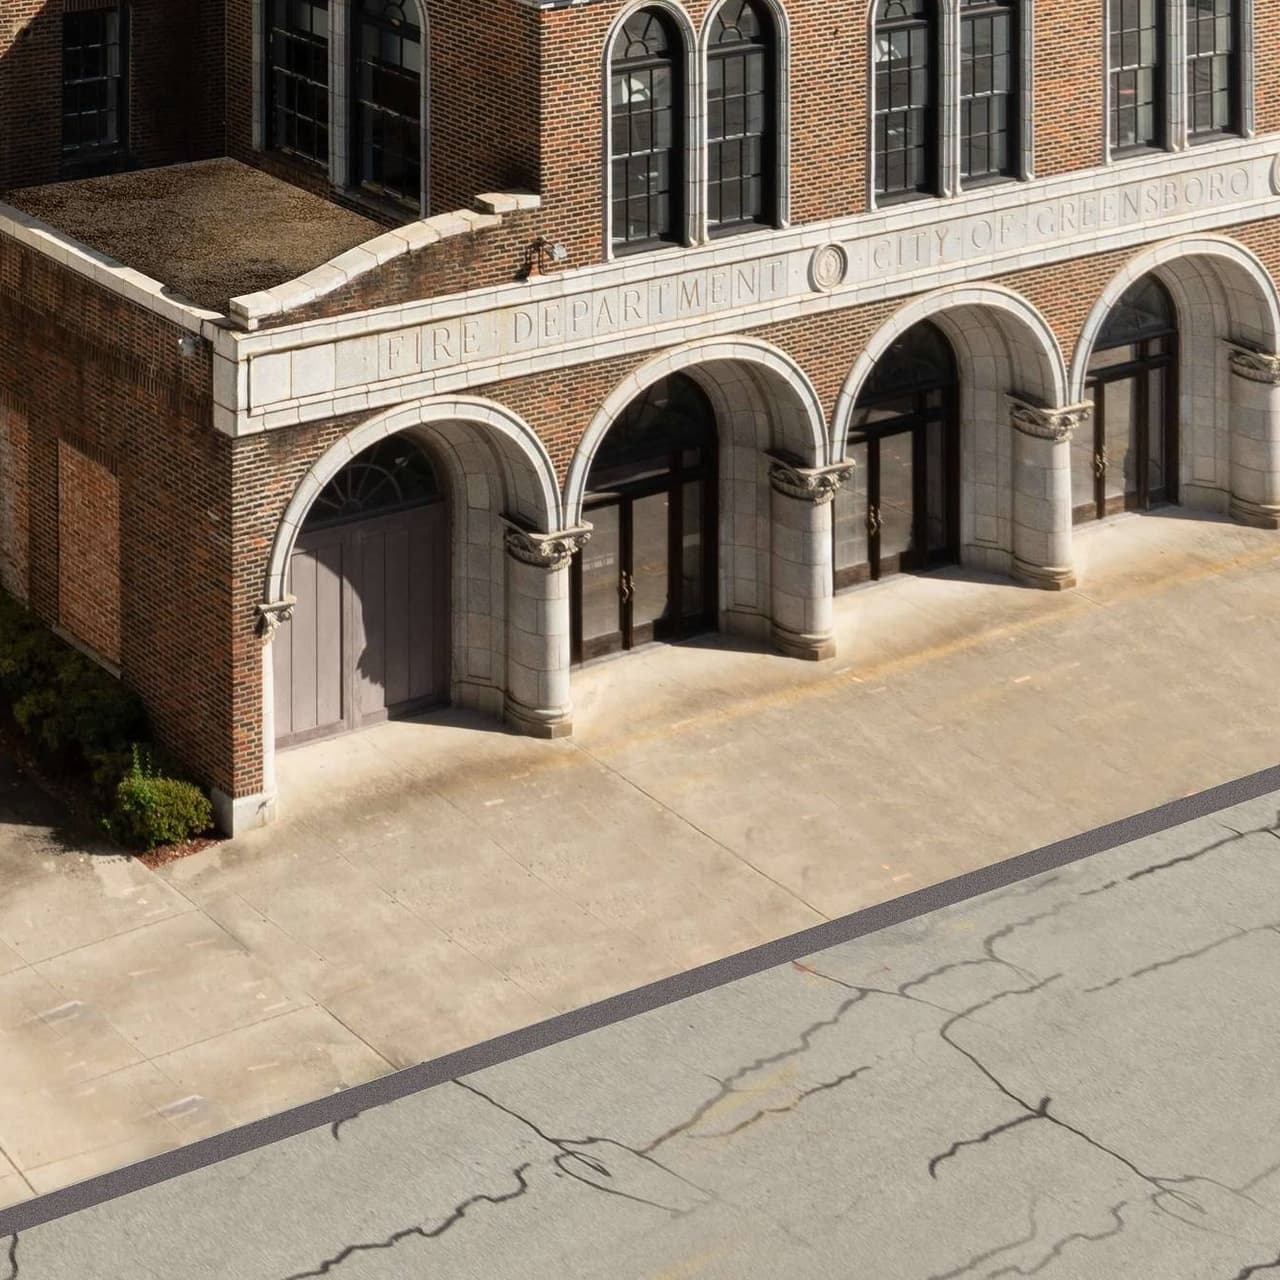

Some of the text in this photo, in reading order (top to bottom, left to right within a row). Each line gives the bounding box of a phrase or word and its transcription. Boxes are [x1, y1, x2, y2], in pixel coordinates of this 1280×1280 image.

[388, 167, 1250, 370] FIRE DEPARTMENT CITY OF GREENSBORO
